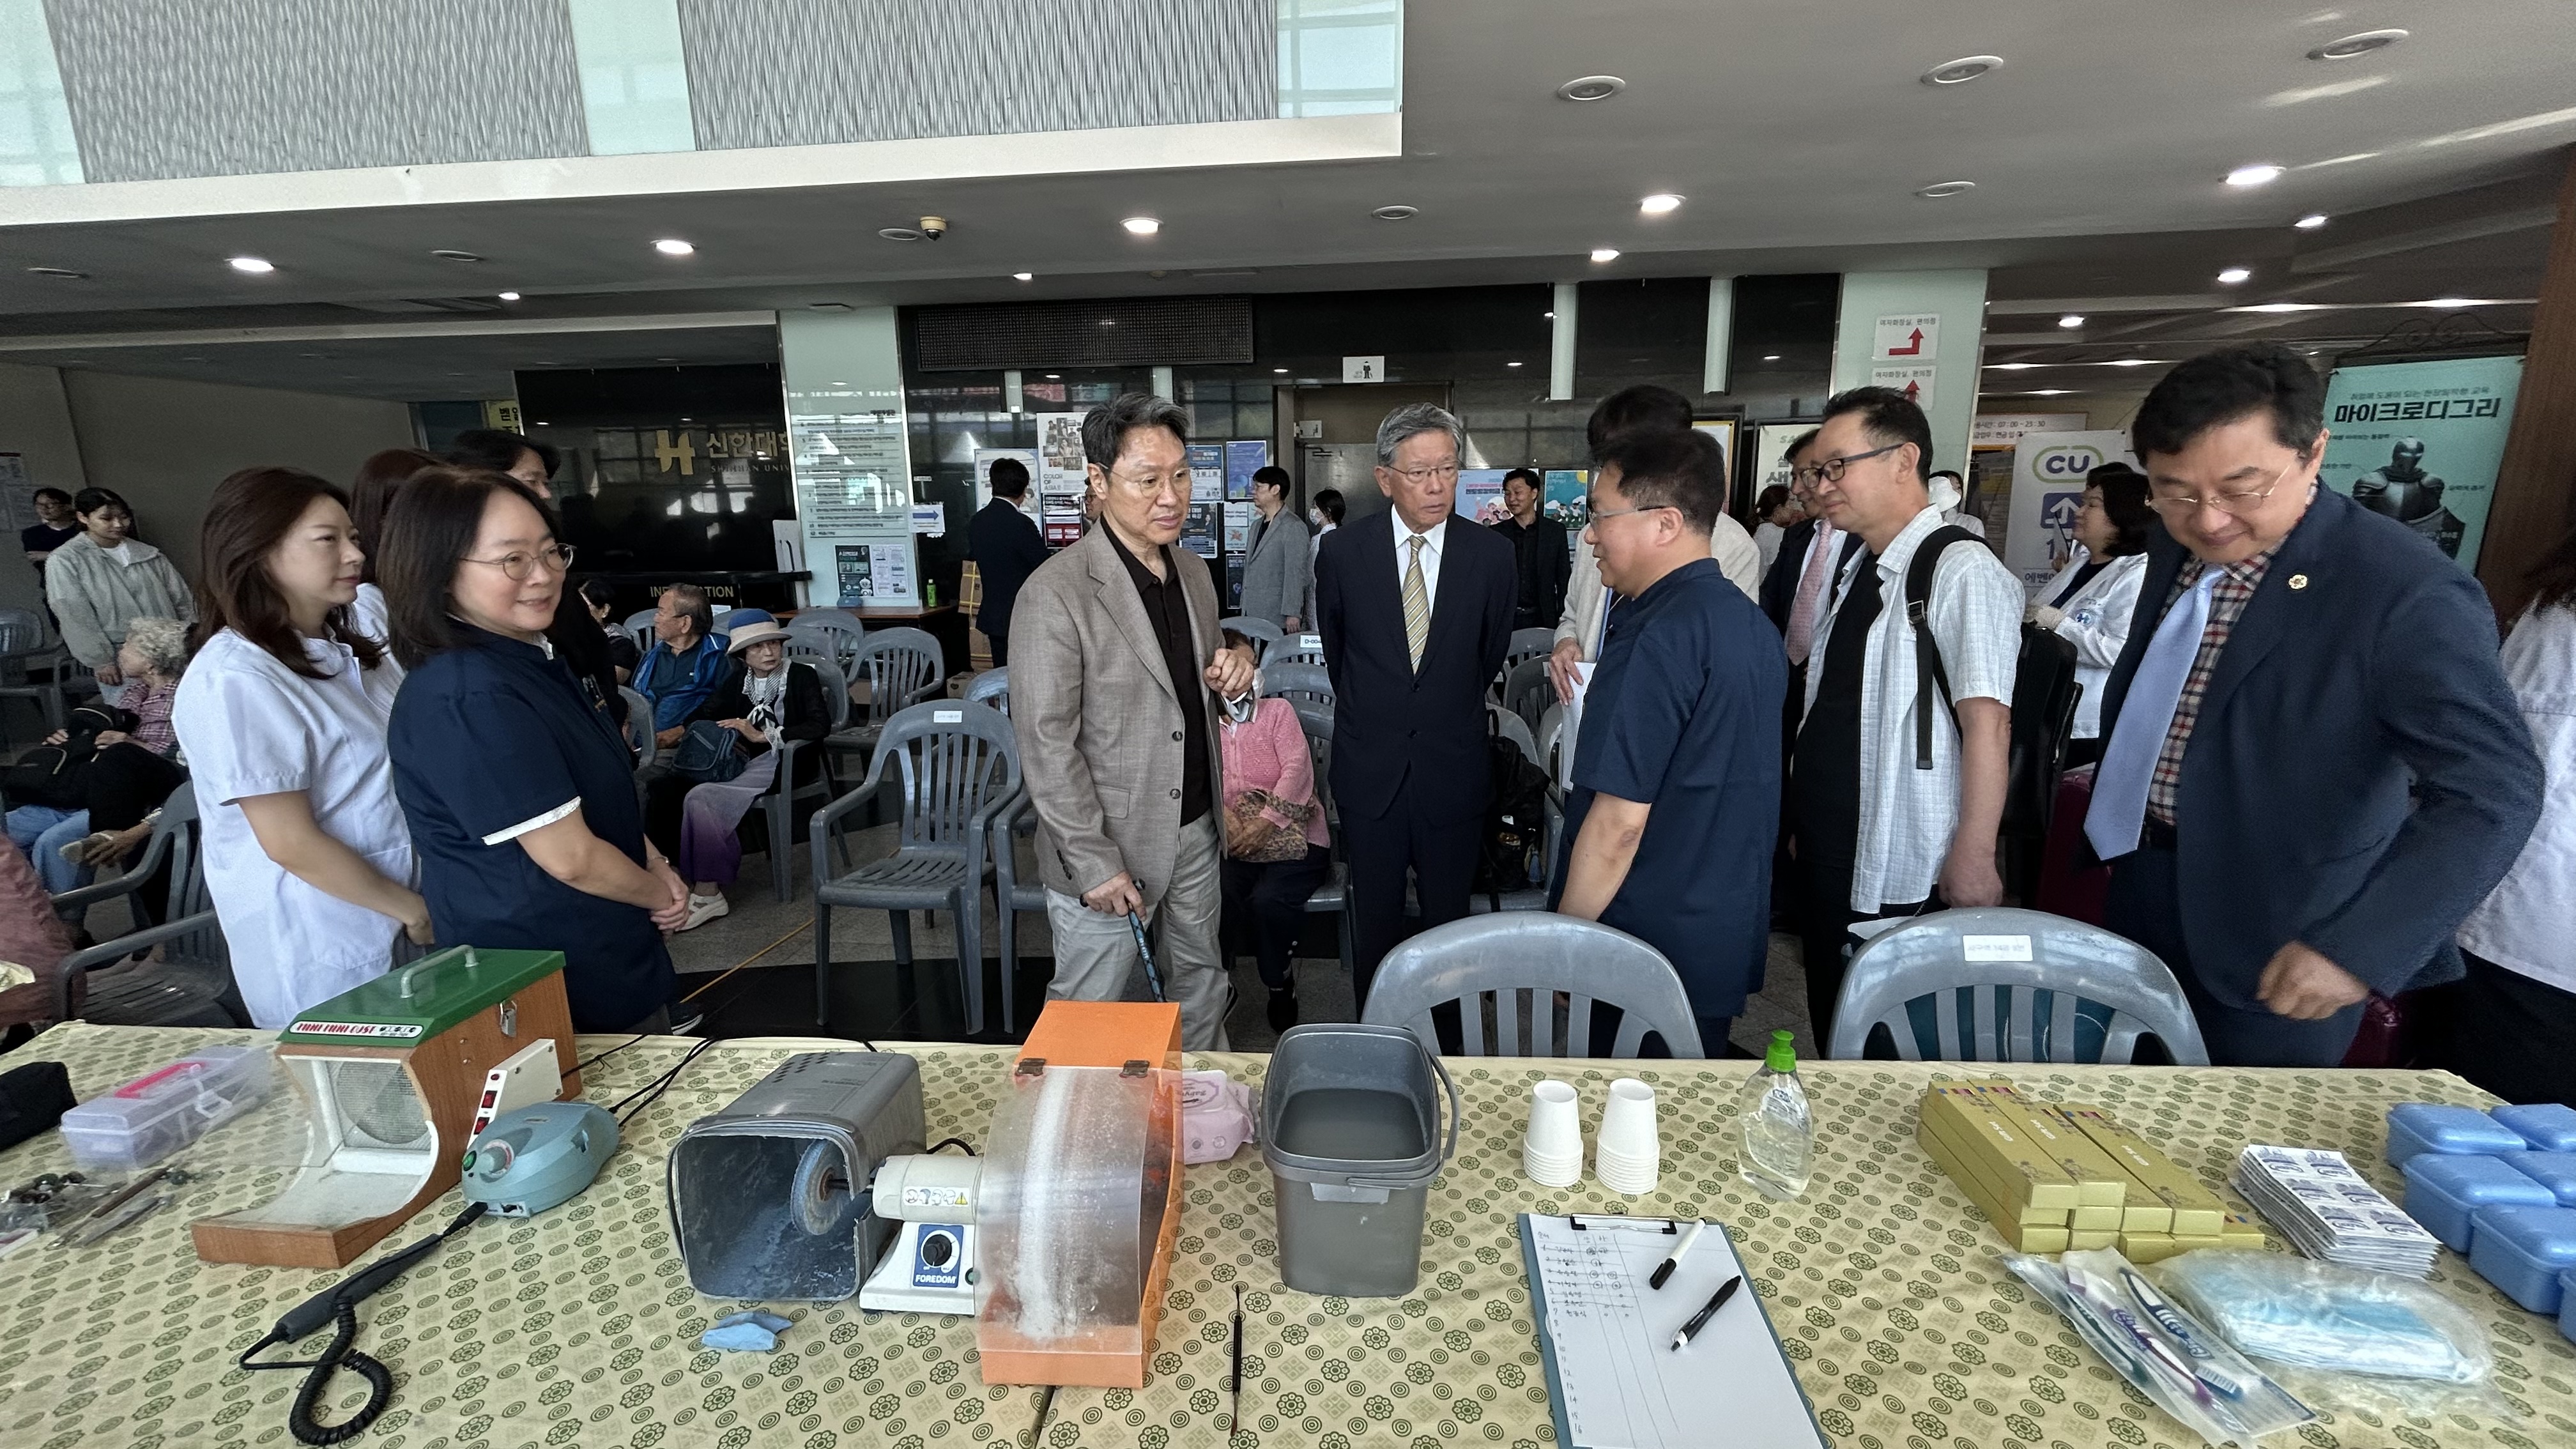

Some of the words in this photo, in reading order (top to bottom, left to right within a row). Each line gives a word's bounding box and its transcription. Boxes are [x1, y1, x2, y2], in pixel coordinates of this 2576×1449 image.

[2334, 397, 2501, 423] 마이크로디그리
[2046, 455, 2090, 474] CU
[650, 586, 735, 597] INFTION
[915, 1274, 957, 1284] FOREDOM
